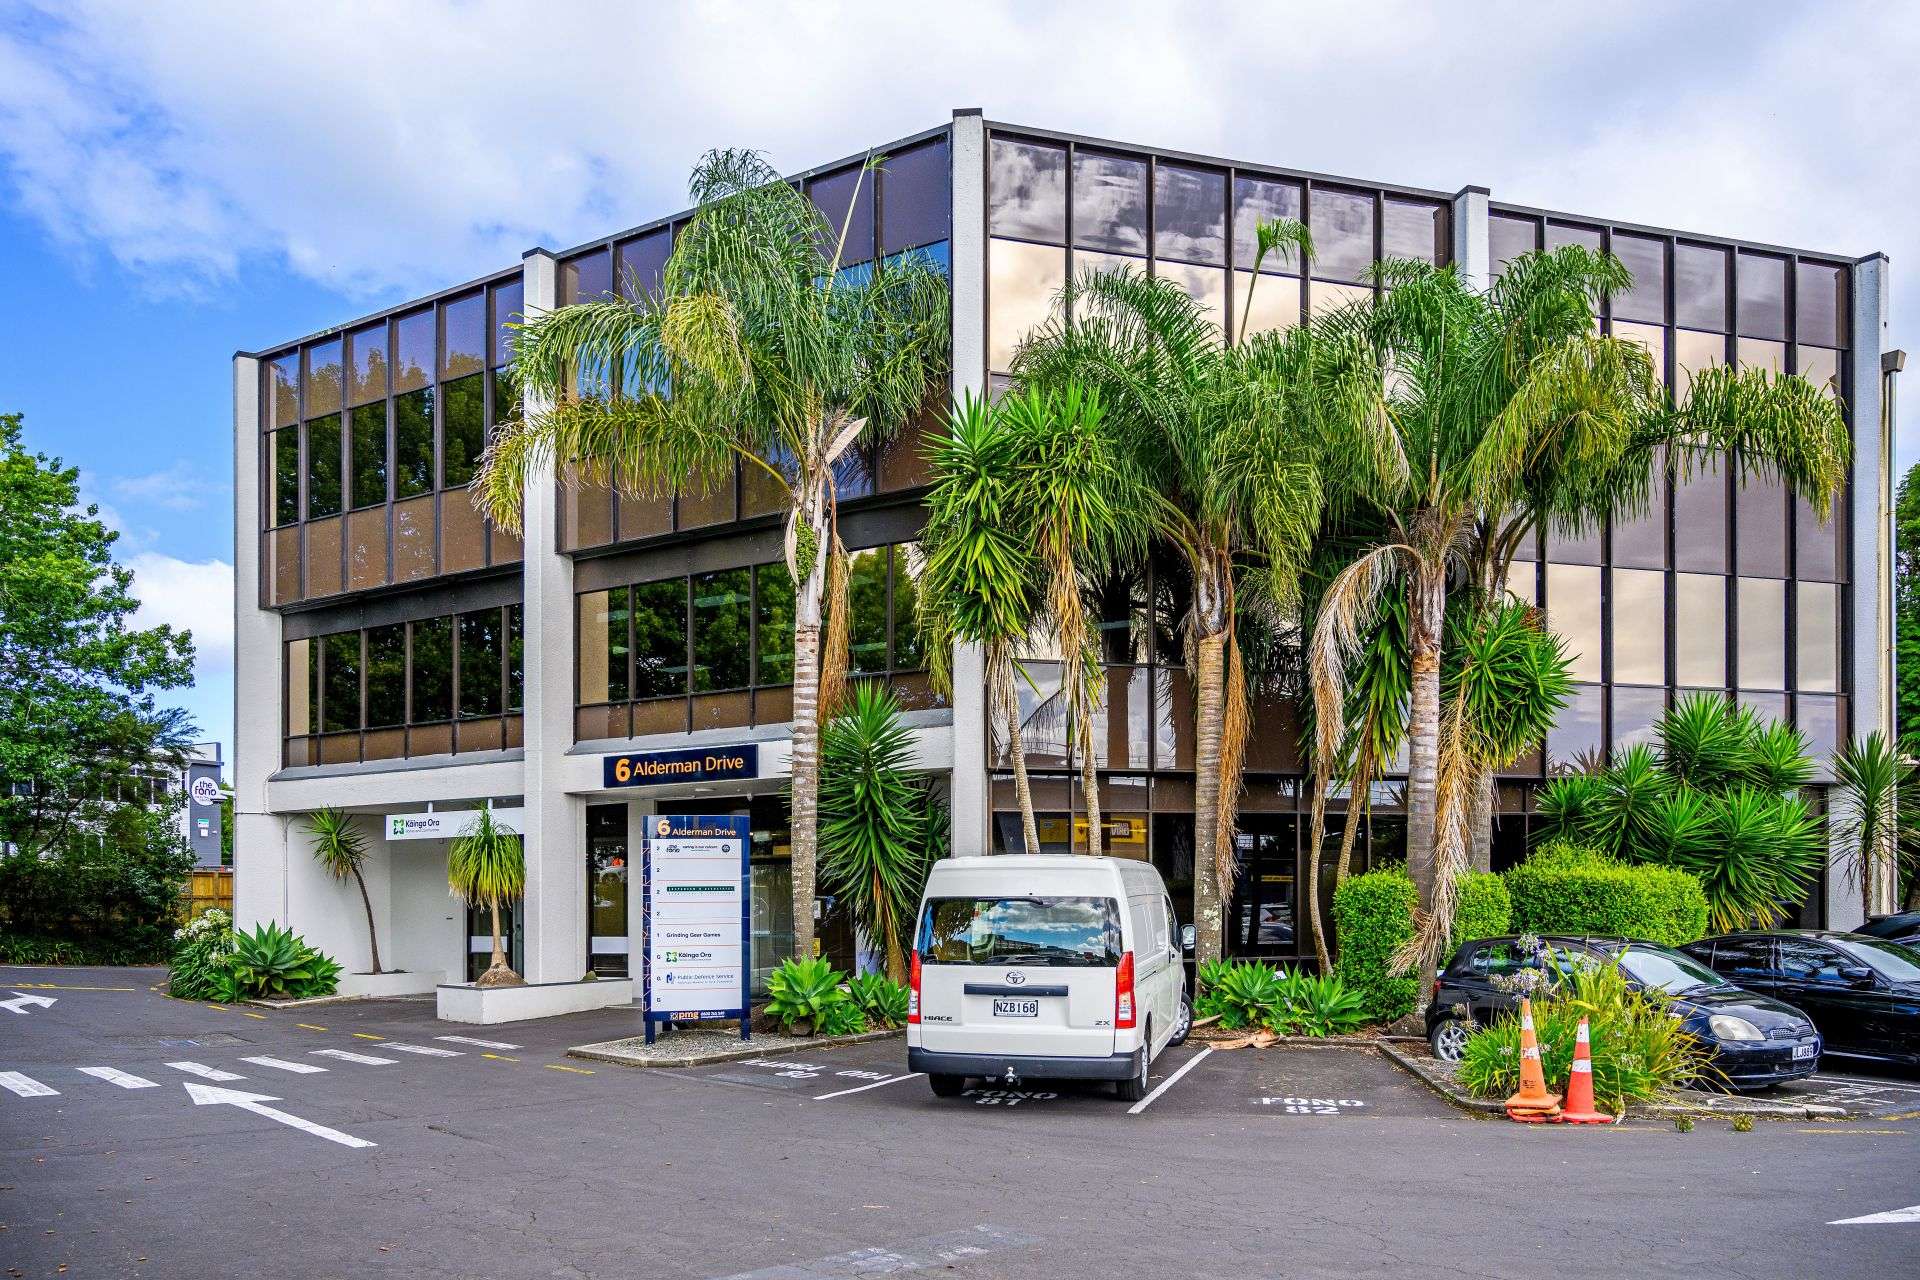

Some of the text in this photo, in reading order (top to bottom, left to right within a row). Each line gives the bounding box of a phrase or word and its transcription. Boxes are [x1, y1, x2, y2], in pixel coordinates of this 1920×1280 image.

[615, 755, 744, 782] 6 Alderman Drive
[427, 818, 440, 827] Ora
[657, 819, 737, 836] 6 Alderman Drive
[995, 1002, 1036, 1014] NZB168
[679, 1011, 699, 1020] pmg
[1262, 1097, 1364, 1107] FONO
[1285, 1105, 1341, 1114] 82
